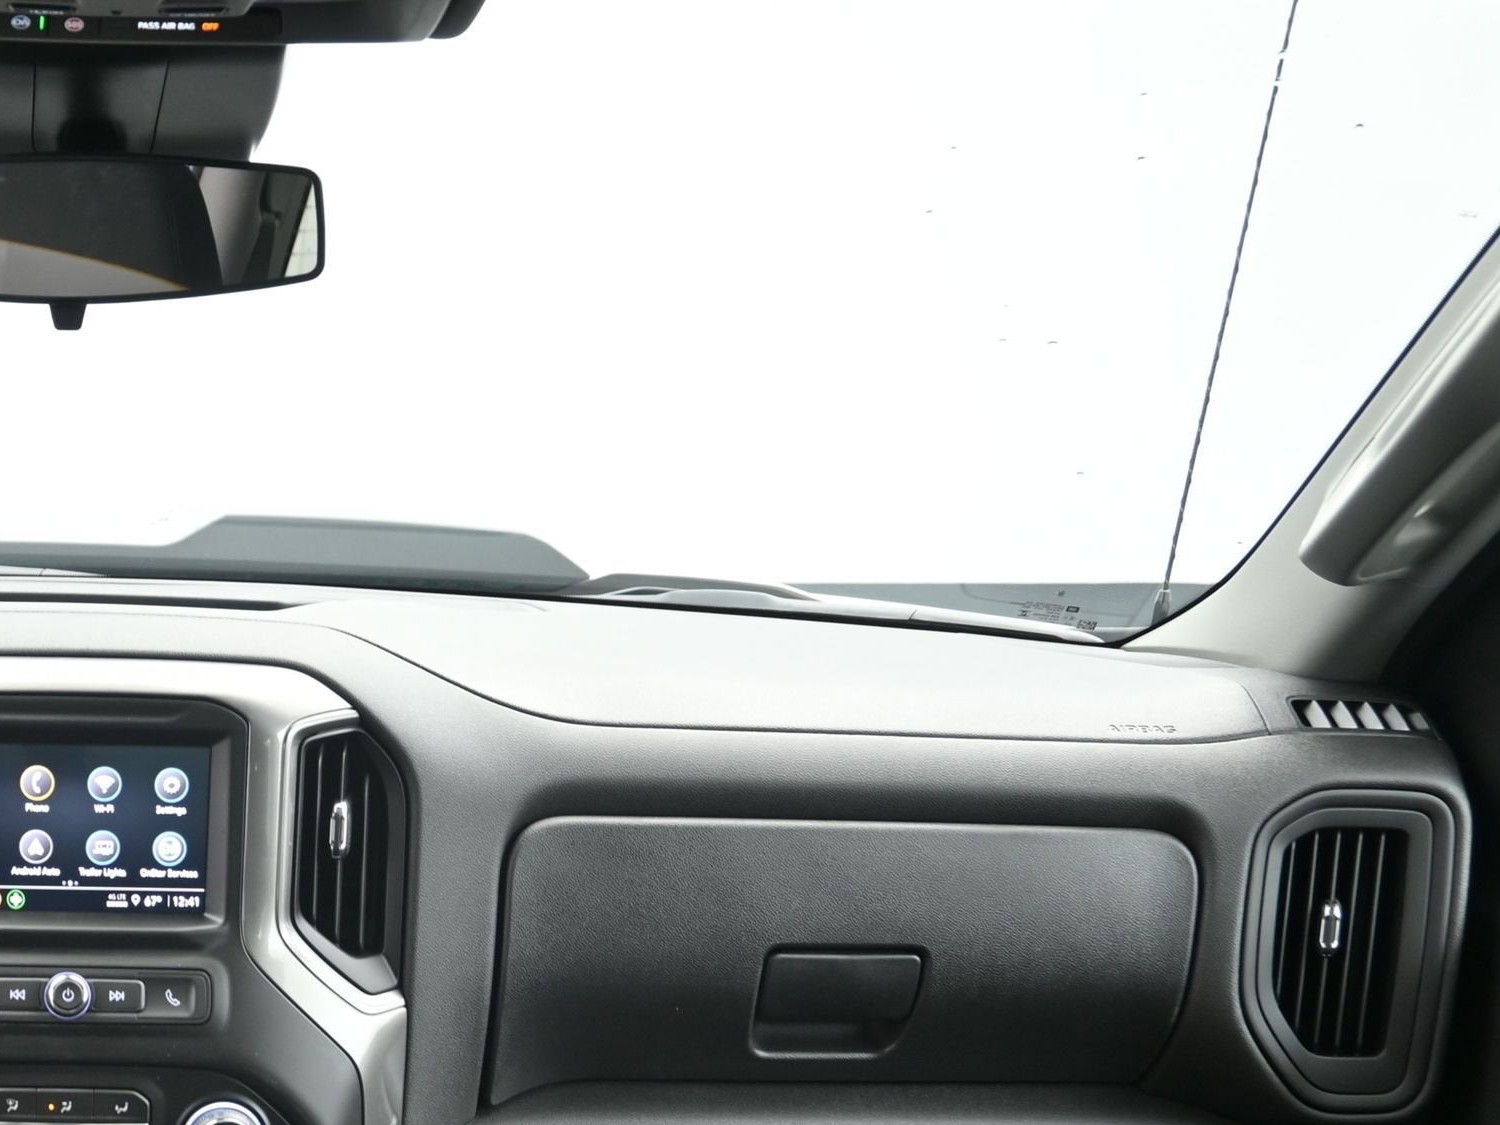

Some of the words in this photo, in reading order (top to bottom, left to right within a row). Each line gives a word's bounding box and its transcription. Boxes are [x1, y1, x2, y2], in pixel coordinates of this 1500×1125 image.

[138, 22, 160, 30] PASS
[161, 22, 176, 30] AIR
[178, 22, 195, 30] BAG
[202, 22, 219, 31] OFF
[1108, 724, 1177, 734] AIRBAG
[24, 802, 50, 813] Phone
[94, 804, 115, 814] Wi-Fi
[155, 805, 187, 817] Settings
[11, 866, 41, 876] Android
[42, 866, 61, 876] Auto
[78, 867, 102, 877] Trailer
[103, 867, 127, 879] Lights
[140, 868, 166, 878] OnStar
[167, 868, 199, 878] Services
[173, 896, 200, 907] 12:41
